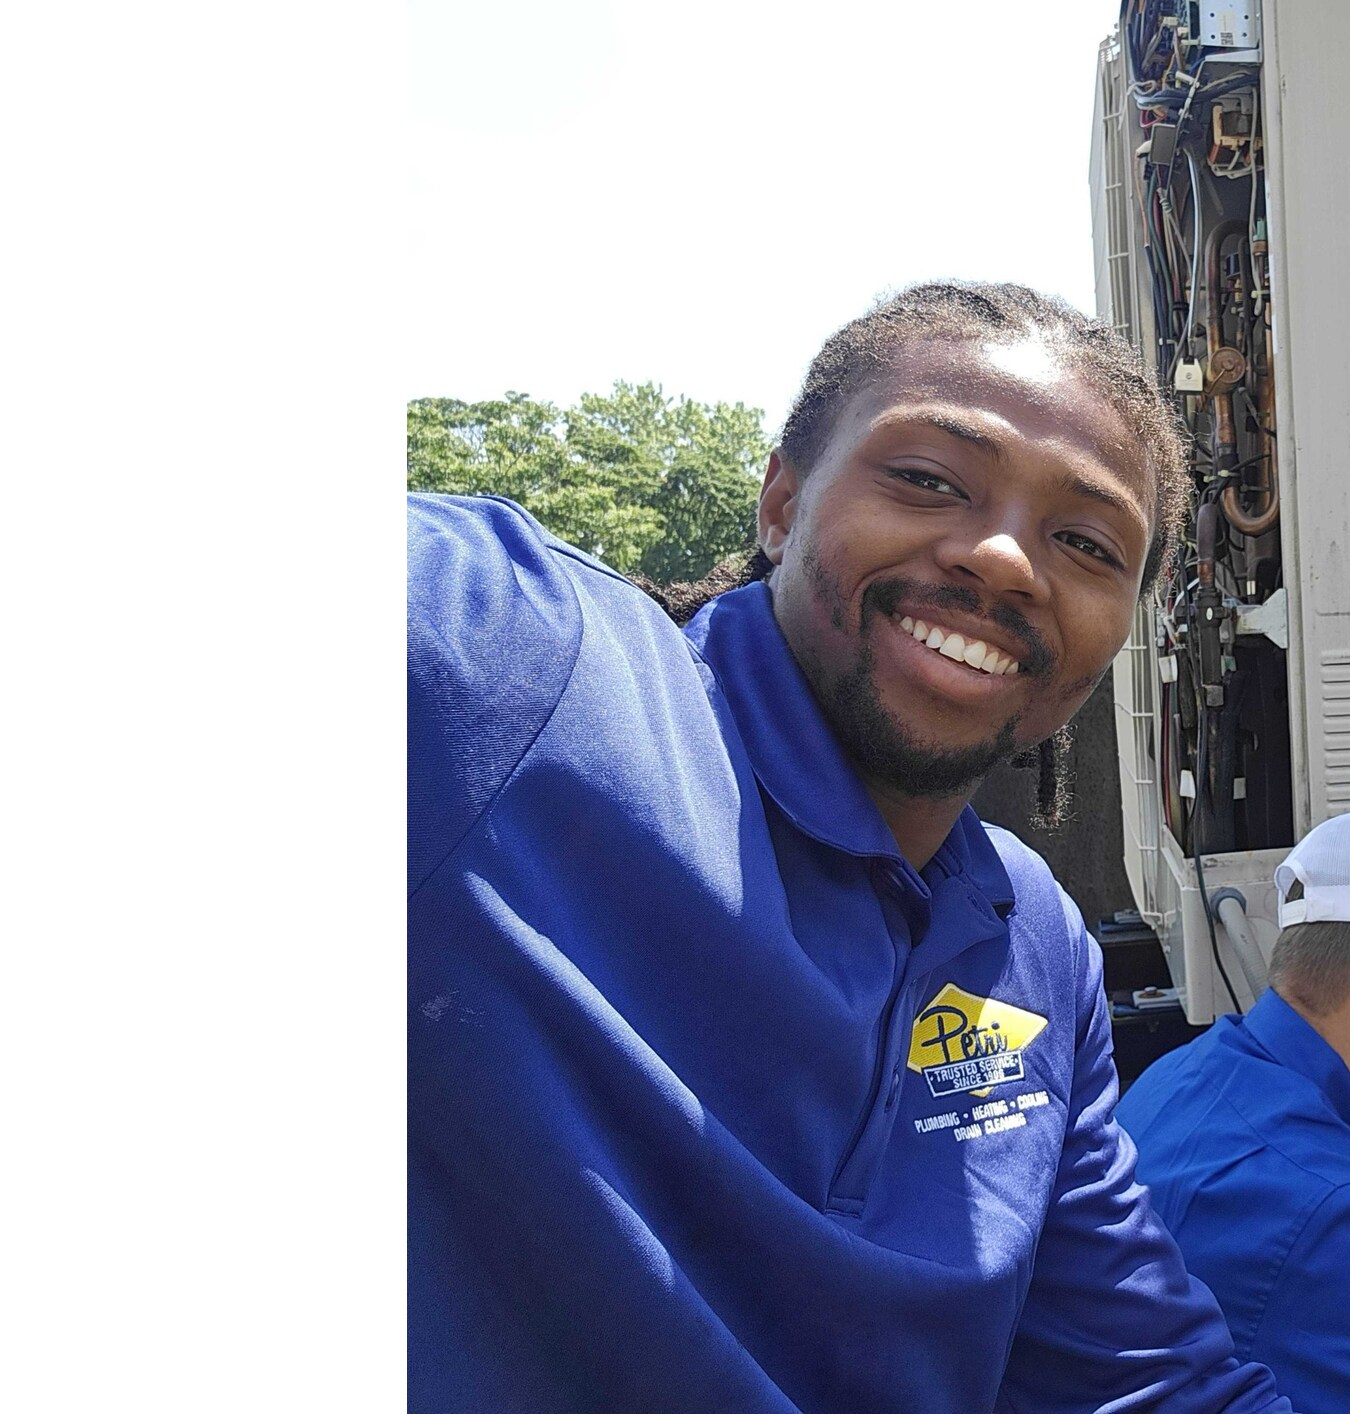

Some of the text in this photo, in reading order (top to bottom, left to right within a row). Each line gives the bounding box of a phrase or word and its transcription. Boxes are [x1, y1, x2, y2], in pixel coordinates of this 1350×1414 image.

[919, 1005, 1008, 1064] Petri
[934, 1055, 1018, 1083] TRUSTED SERVICE
[953, 1072, 983, 1089] SINCE
[914, 1090, 1050, 1133] PLUMBING HEATING COOLING
[953, 1112, 1027, 1142] DRAIN CLEANING
